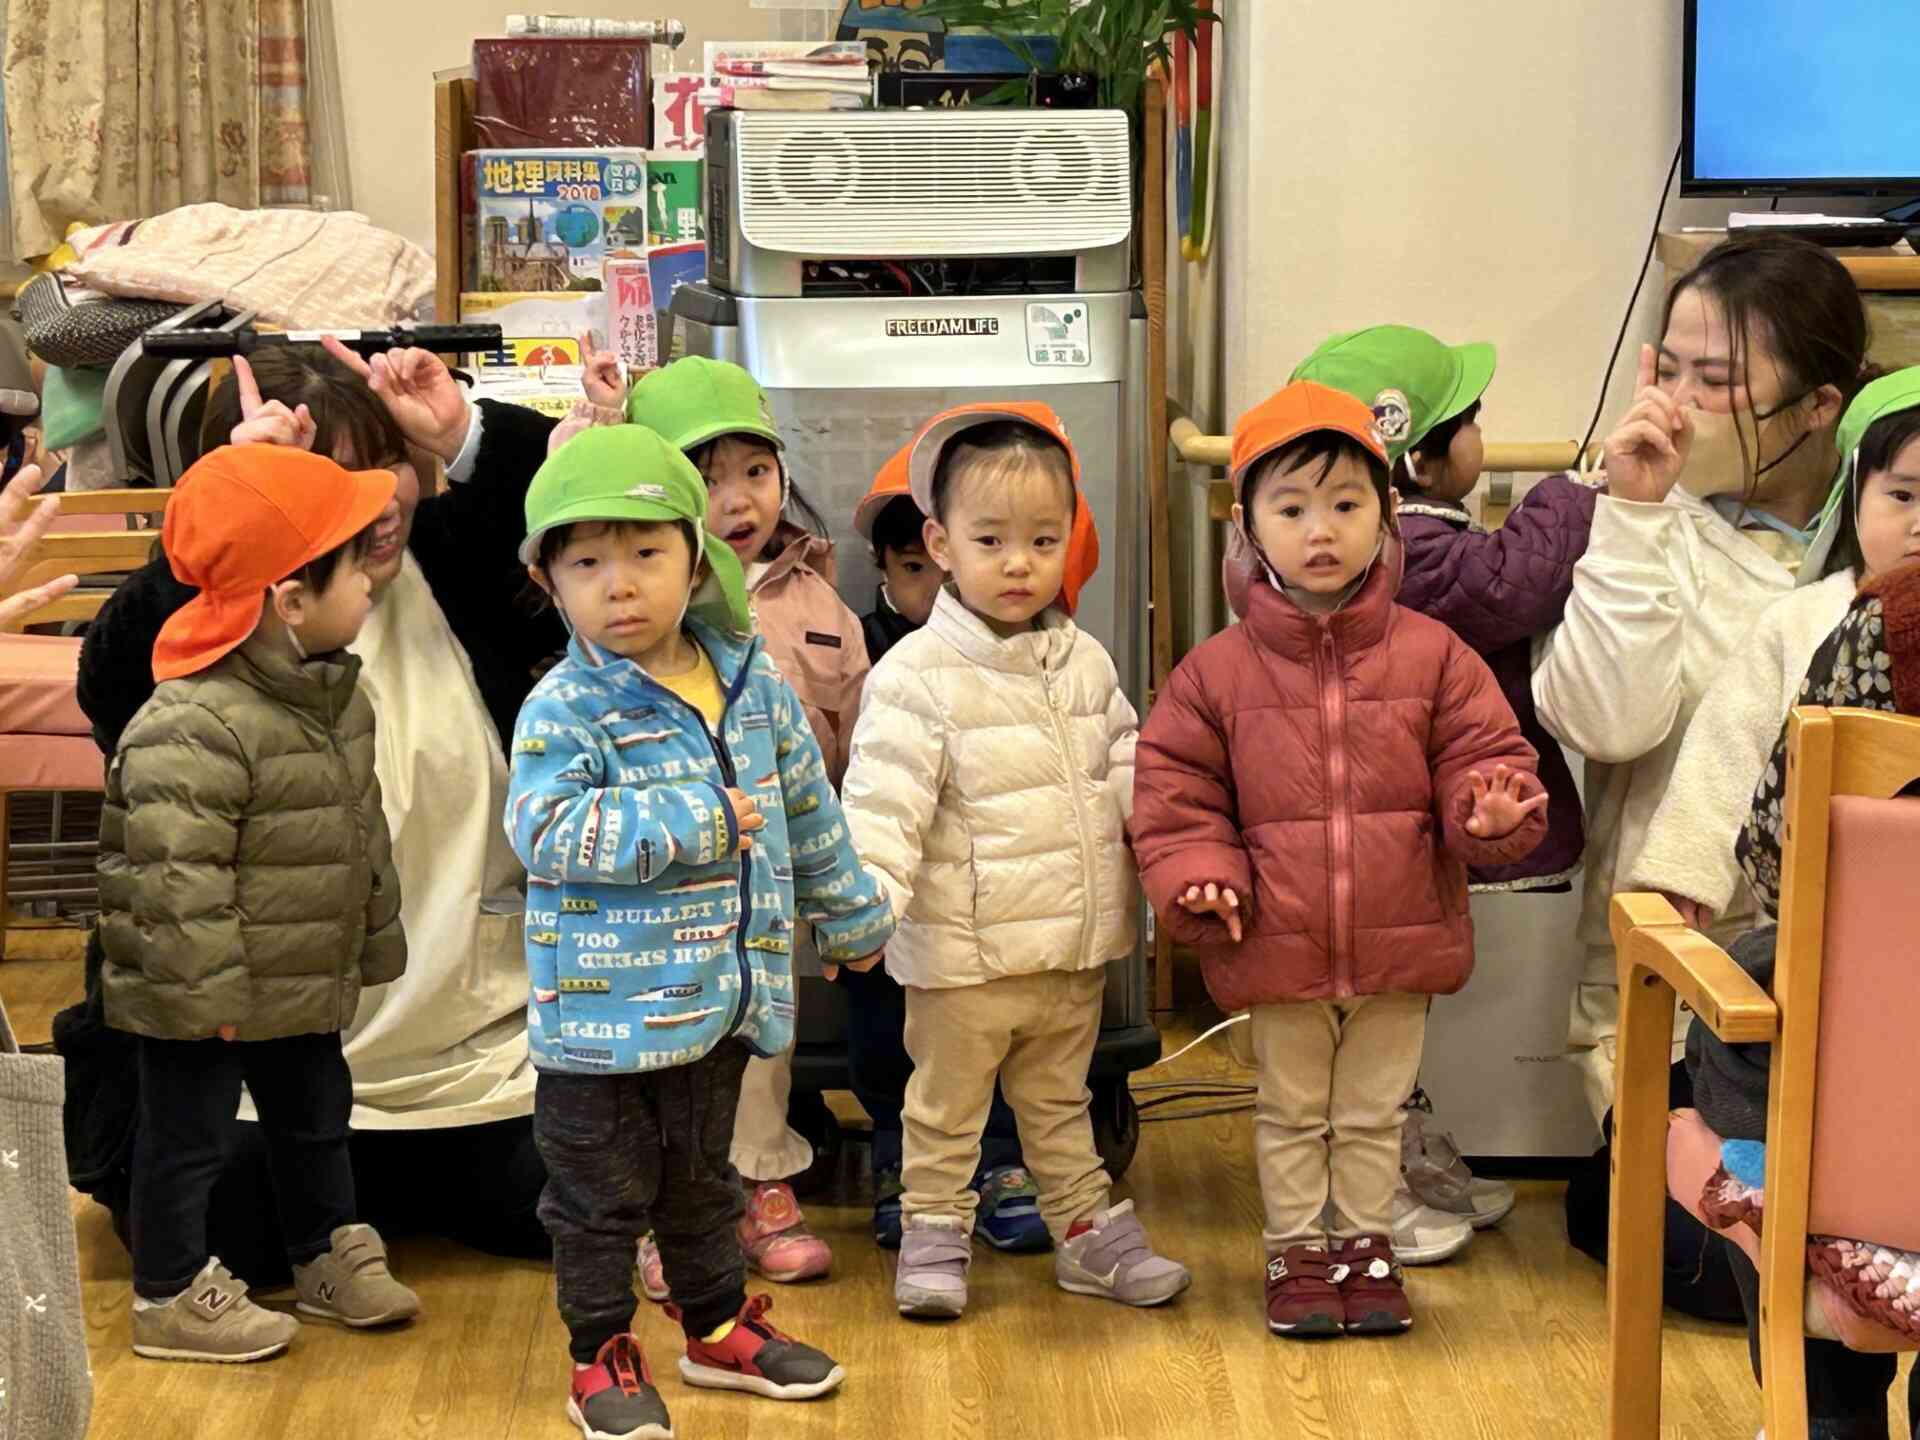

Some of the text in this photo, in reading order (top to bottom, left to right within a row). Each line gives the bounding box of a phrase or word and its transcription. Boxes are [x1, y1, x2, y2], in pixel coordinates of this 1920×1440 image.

[483, 159, 600, 193] 地理資料集
[557, 185, 601, 201] 2018
[572, 931, 622, 949] 700
[196, 1286, 231, 1311] N
[317, 1281, 337, 1303] N
